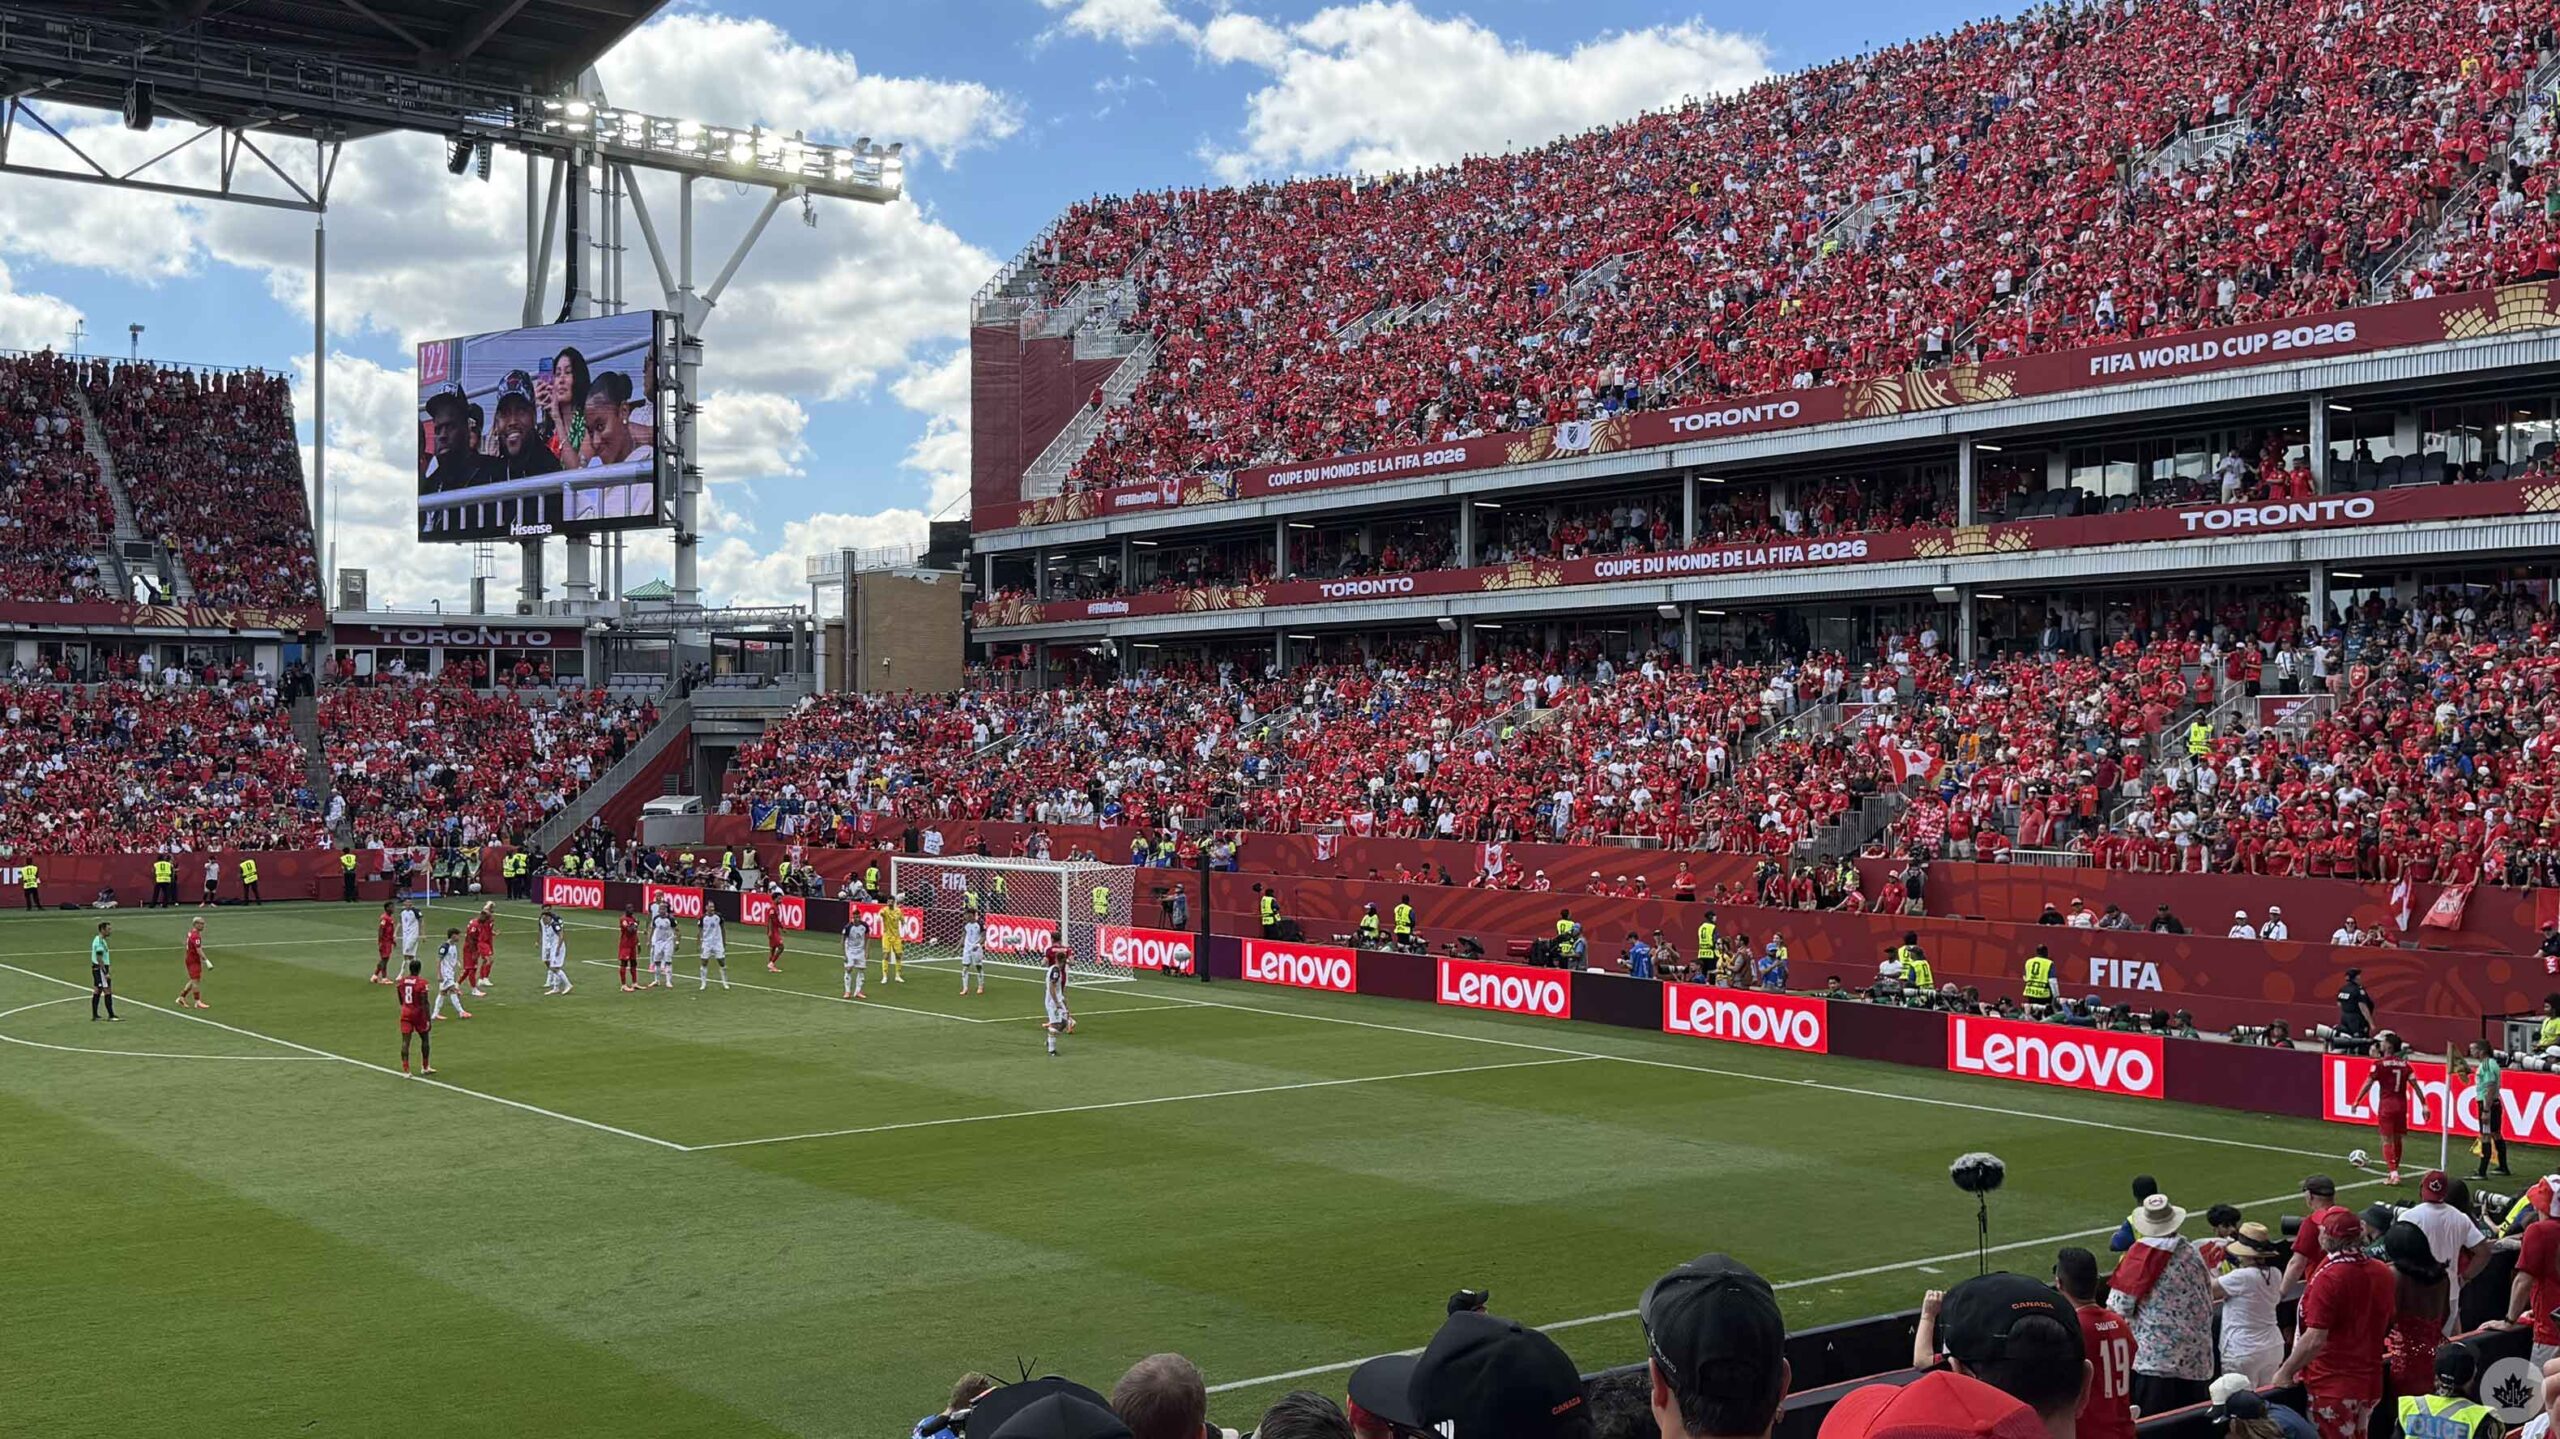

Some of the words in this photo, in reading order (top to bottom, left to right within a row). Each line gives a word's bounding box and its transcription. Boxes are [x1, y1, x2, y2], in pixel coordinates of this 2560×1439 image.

[420, 344, 445, 381] 122
[2090, 353, 2135, 376] FIFA
[2138, 340, 2219, 368] WORLD
[2222, 332, 2269, 358] CUP
[2272, 321, 2356, 350] 2026
[1669, 401, 1800, 432] TORONTO
[1268, 470, 1302, 487] COUPE
[1304, 468, 1320, 483] DU
[1321, 463, 1360, 480] MONDE
[1362, 460, 1377, 475] DE
[1378, 458, 1394, 472] LA
[1395, 454, 1420, 470] FIFA
[1423, 447, 1466, 465] 2026
[510, 523, 552, 536] Hisense
[2179, 497, 2375, 531] TORONTO
[1594, 560, 1641, 577] COUPE
[1643, 558, 1664, 573] DU
[1666, 553, 1720, 572] MONDE
[1723, 551, 1743, 567] DE
[1746, 548, 1767, 565] LA
[1769, 545, 1802, 563] FIFA
[1807, 540, 1867, 560] 2026
[1320, 577, 1414, 597] TORONTO
[380, 629, 551, 645] TORONTO
[545, 878, 601, 906] Lenovo
[942, 872, 967, 890] FIFA
[645, 885, 700, 917] Lnovo
[743, 894, 802, 927] Lenvo
[986, 924, 1052, 953] enovo
[1246, 942, 1351, 988] Lenovo
[2090, 957, 2163, 992] FIFA
[404, 986, 413, 1004] 8
[1442, 961, 1565, 1014] Lenovo
[1668, 985, 1820, 1048] Lenovo
[1955, 1019, 2154, 1092] Lenovo
[2392, 1069, 2401, 1092] 7
[2334, 1060, 2560, 1142] Lnov
[2100, 1338, 2130, 1398] 19
